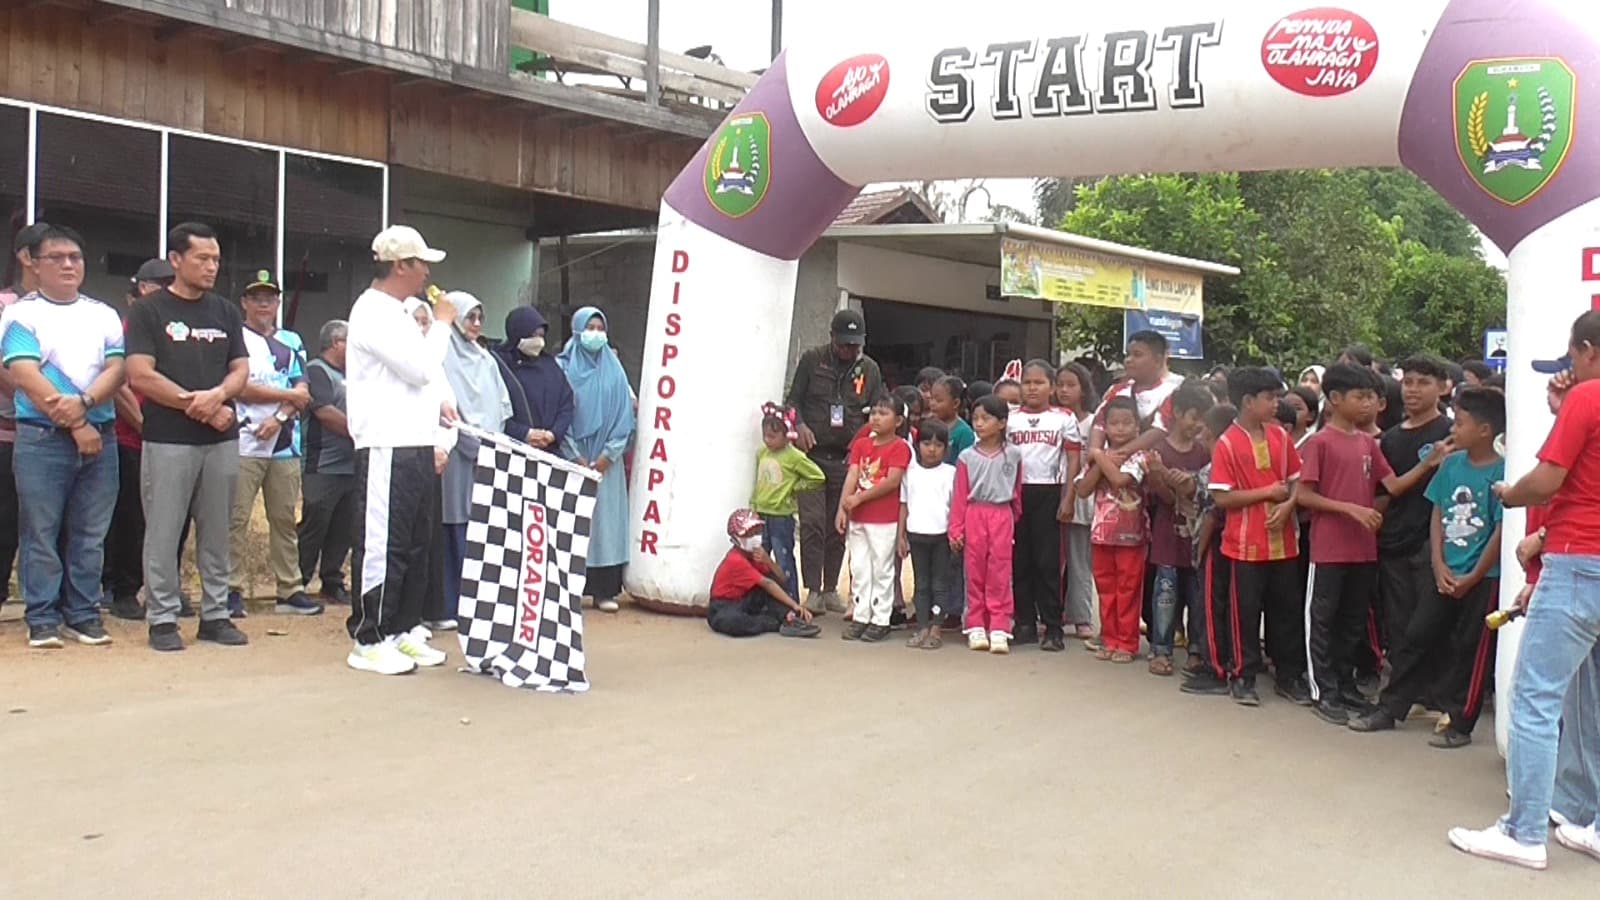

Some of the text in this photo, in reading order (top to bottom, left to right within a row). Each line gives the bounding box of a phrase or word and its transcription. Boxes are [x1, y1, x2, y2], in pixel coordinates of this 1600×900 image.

[1266, 34, 1353, 52] MAJU
[1268, 18, 1353, 41] PEMUDA
[925, 18, 1225, 124] START
[1267, 49, 1363, 68] OLAHRAGA
[825, 70, 881, 120] OLAHRAGA
[1305, 68, 1358, 88] JAYA
[640, 249, 690, 556] DISPORAPAR
[519, 504, 545, 644] PORAPAR
